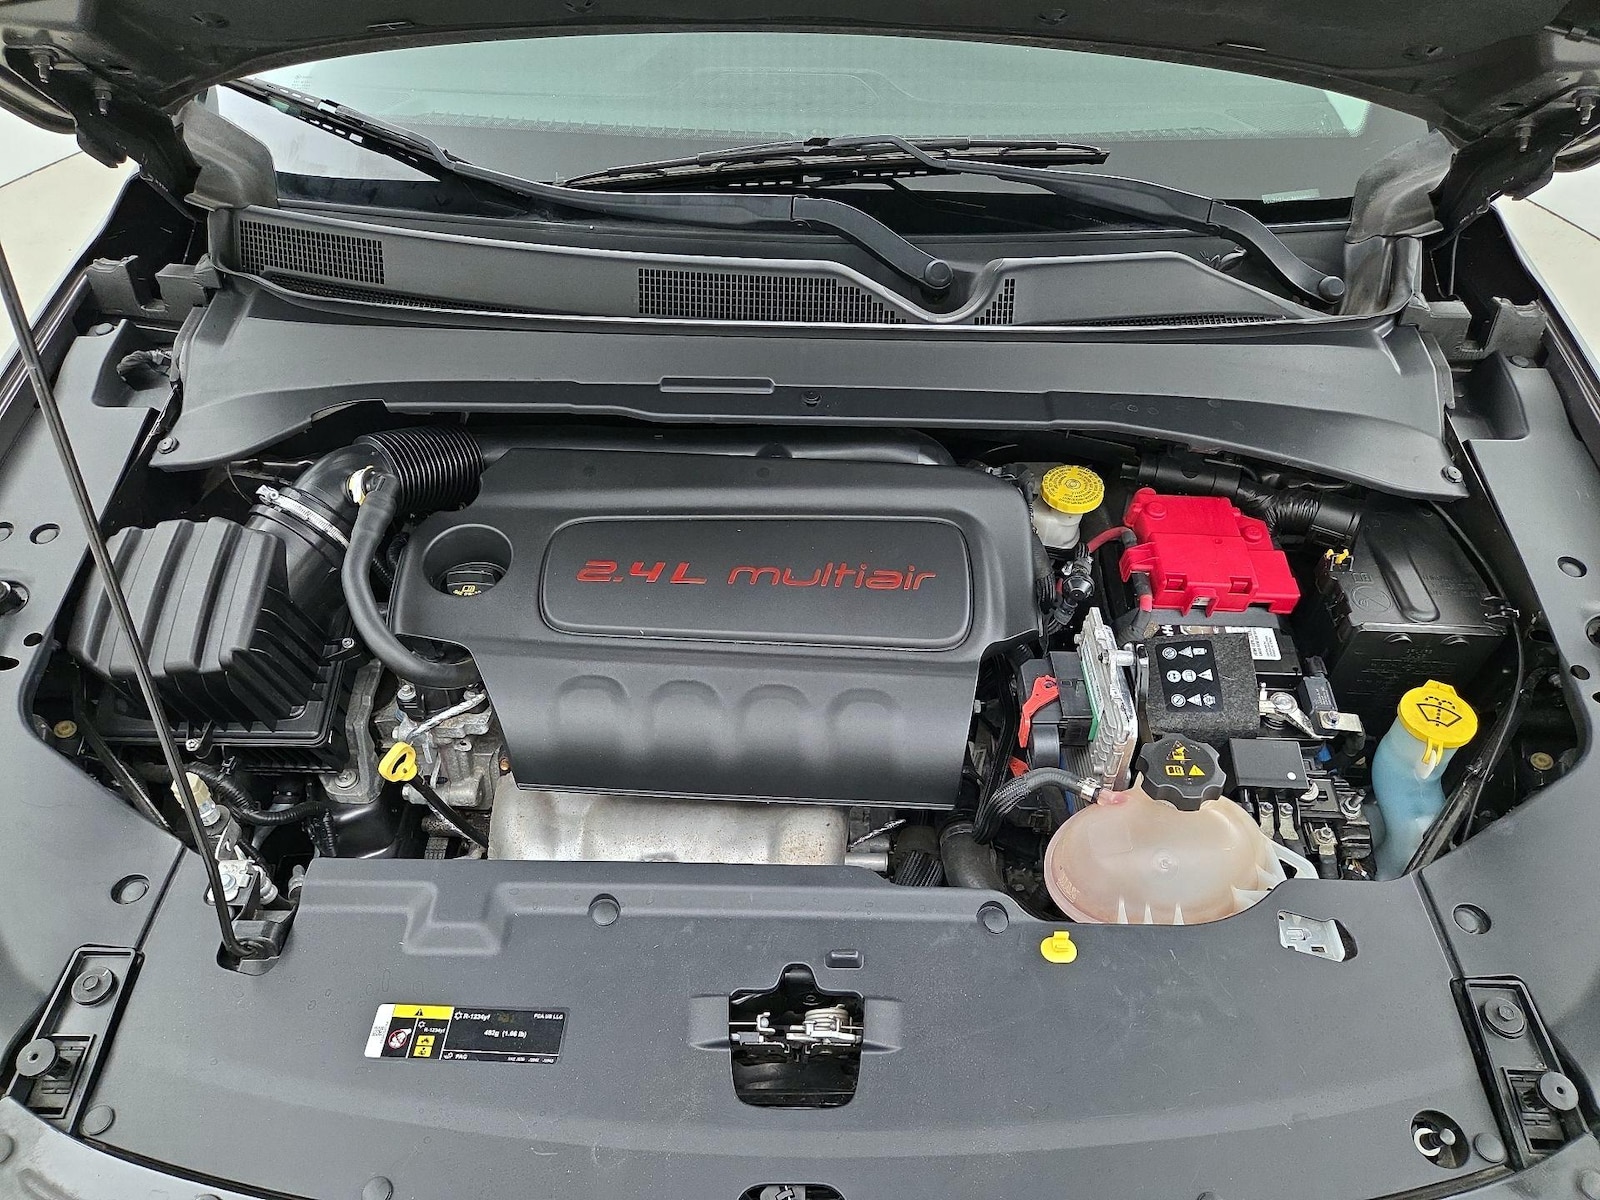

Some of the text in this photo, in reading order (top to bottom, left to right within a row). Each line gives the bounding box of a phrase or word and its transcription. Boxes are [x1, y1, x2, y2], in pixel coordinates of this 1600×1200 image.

[727, 562, 936, 590] multiair
[463, 1013, 491, 1021] R-1234yf
[424, 1026, 445, 1034] R-1234yf
[454, 1052, 468, 1060] PAG
